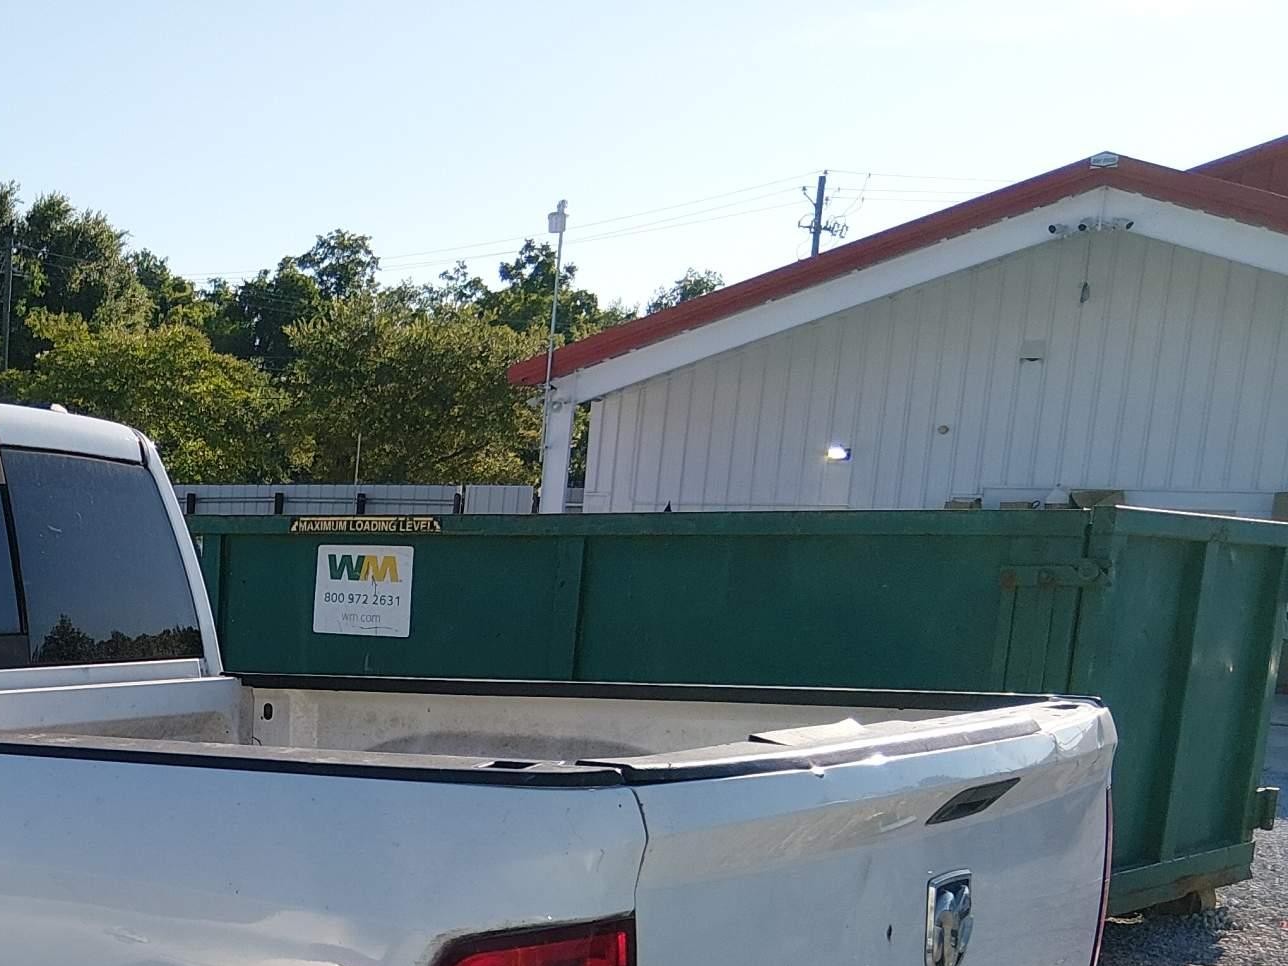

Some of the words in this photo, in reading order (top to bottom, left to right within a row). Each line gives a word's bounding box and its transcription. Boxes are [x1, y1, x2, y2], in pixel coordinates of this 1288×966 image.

[299, 520, 347, 532] MAXIMUM
[349, 520, 397, 532] LOADING
[399, 520, 432, 532] LEVEL
[327, 554, 399, 582] WM
[324, 592, 345, 603] 800
[348, 593, 369, 605] 972
[372, 594, 400, 606] 2631
